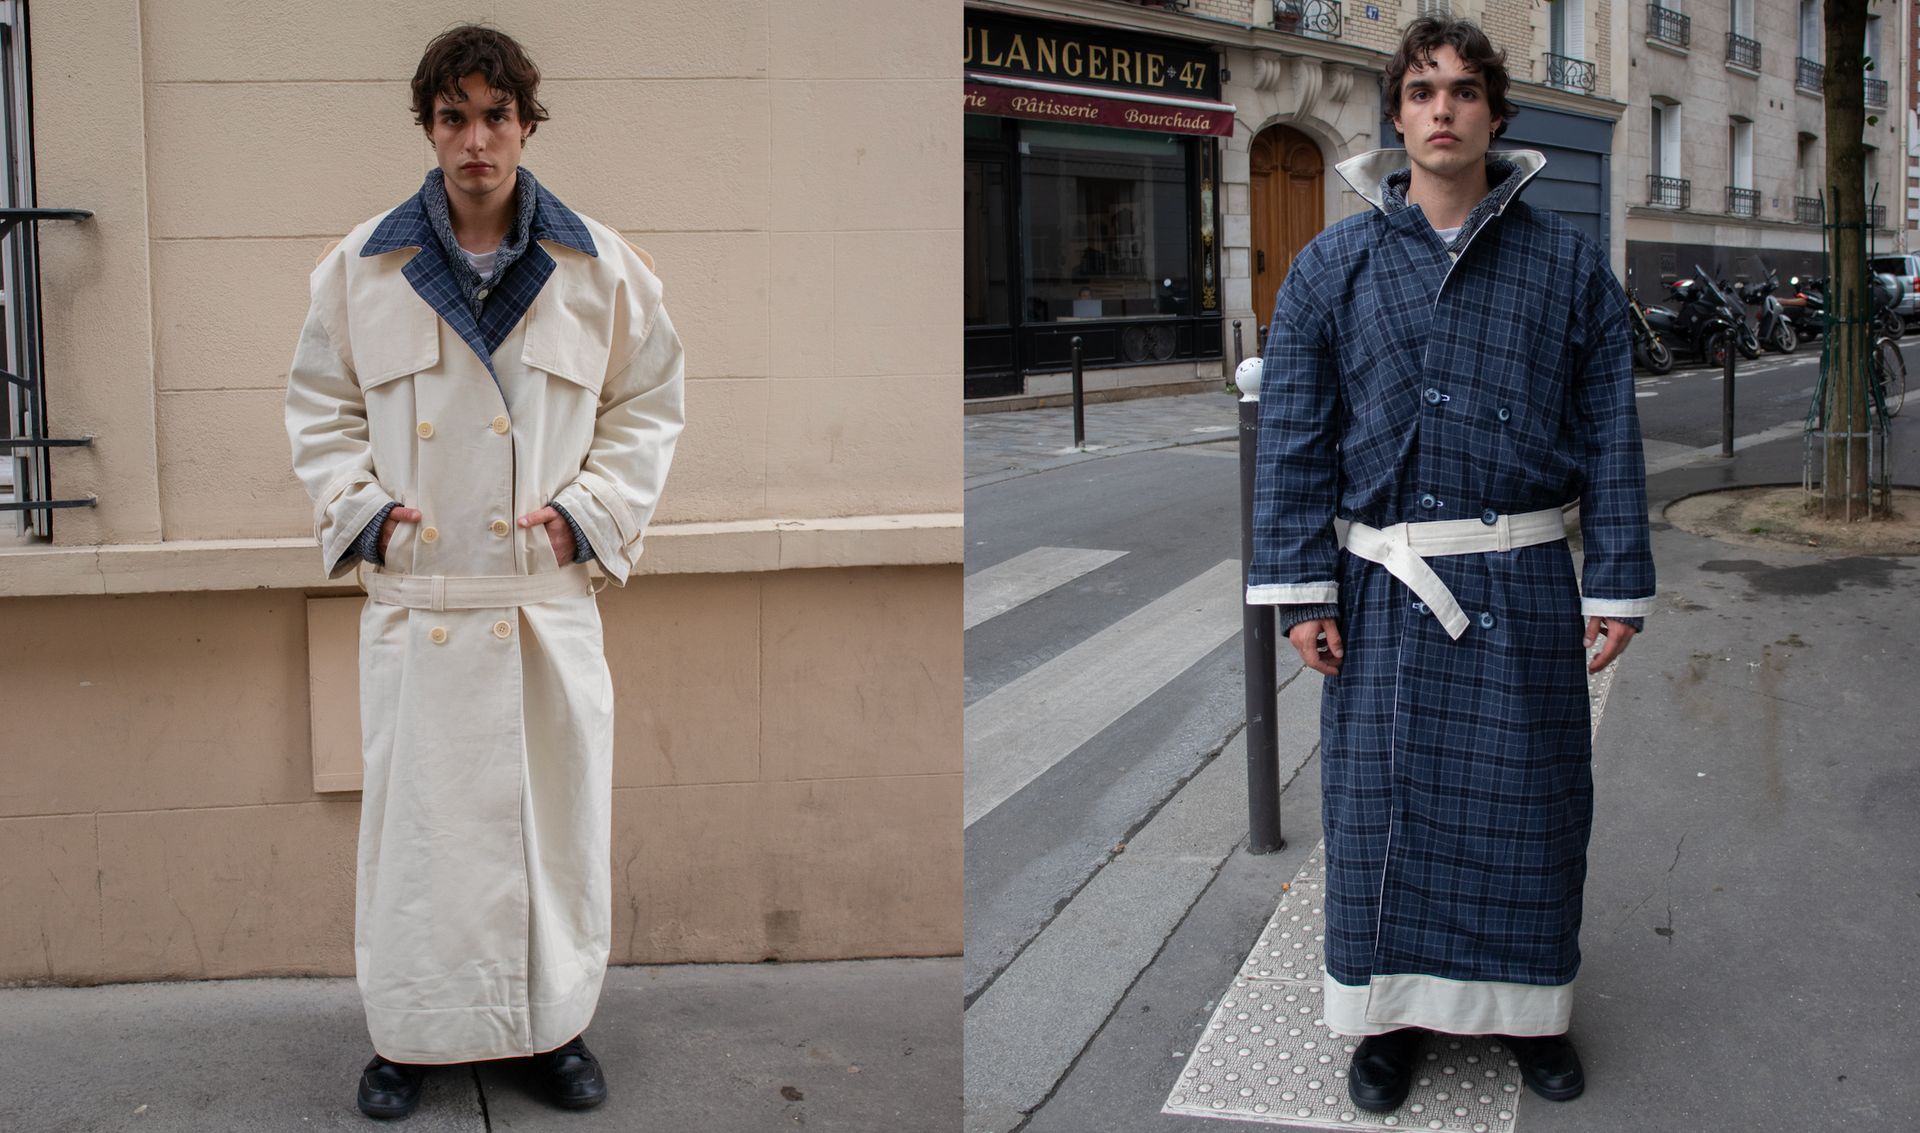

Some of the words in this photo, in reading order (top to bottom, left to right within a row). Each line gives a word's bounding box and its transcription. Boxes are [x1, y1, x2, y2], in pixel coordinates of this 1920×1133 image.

[1367, 7, 1378, 20] 47
[1179, 61, 1207, 91] 47
[1011, 96, 1100, 119] Pâtisserie
[1124, 109, 1212, 131] Bourchada
